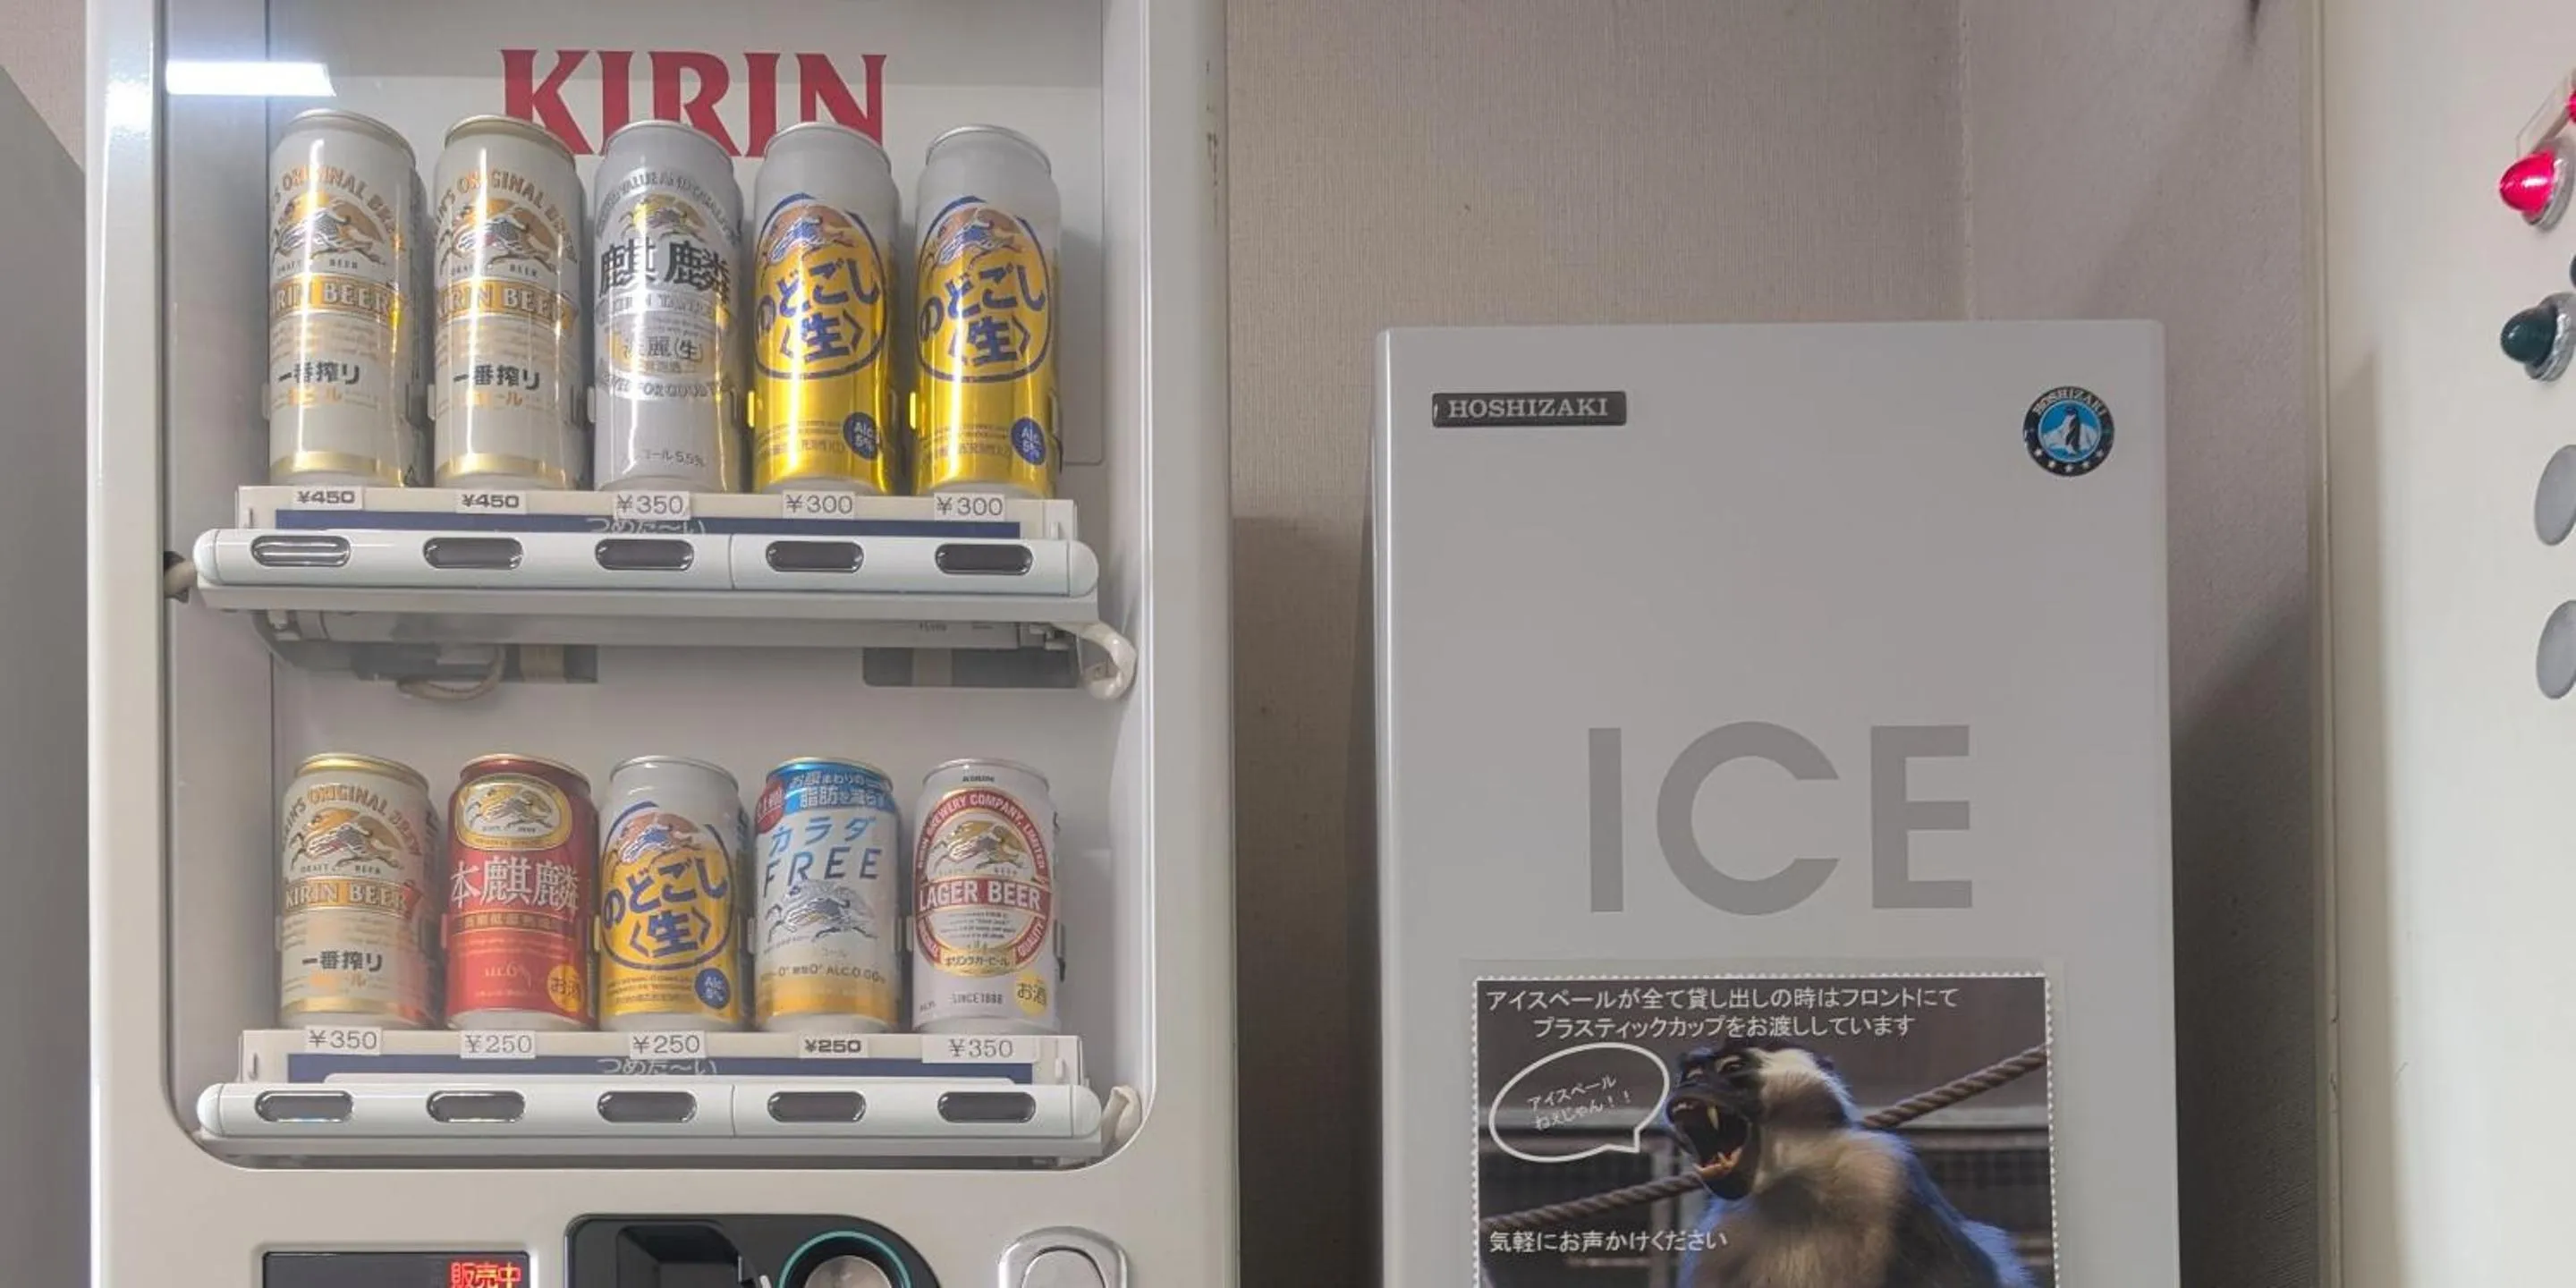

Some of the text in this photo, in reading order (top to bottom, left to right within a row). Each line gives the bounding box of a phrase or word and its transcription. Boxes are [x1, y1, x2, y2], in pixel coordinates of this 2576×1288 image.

[500, 49, 886, 157] KIRIN
[599, 237, 730, 305] 麒麟
[757, 258, 880, 335] のどごし
[920, 262, 1046, 340] のどごし
[277, 361, 360, 386] 一番搾り
[453, 364, 540, 391] 一番搾り
[1447, 397, 1609, 419] HOSHIZAKI
[296, 490, 355, 504] ¥450
[462, 494, 520, 509] ¥450
[616, 494, 683, 514] ¥350
[786, 494, 852, 514] ¥300
[936, 496, 1004, 516] ¥300
[1588, 720, 1973, 916] ICE
[769, 817, 877, 858] カラダ
[450, 853, 581, 912] 本麒麟
[764, 846, 883, 899] FREE
[285, 881, 407, 914] KIRIN BEER
[604, 857, 730, 929] のどごし
[919, 879, 1041, 911] LAGER BEER
[301, 950, 384, 973] 一番搾り
[1017, 983, 1046, 1006] お酒
[1486, 987, 1961, 1011] アイスペールが全て貸し出しの時はフロントにて
[1533, 1014, 1916, 1039] プラスティックカップをお渡ししています
[309, 1030, 377, 1050] ¥350
[465, 1034, 533, 1054] ¥250
[632, 1034, 700, 1054] ¥250
[804, 1039, 861, 1054] ¥250
[949, 1038, 1014, 1058] ¥350
[1526, 1073, 1616, 1113] アイスペール
[1489, 1231, 1729, 1254] 気軽にお声かけください
[450, 1260, 522, 1288] 販売中
